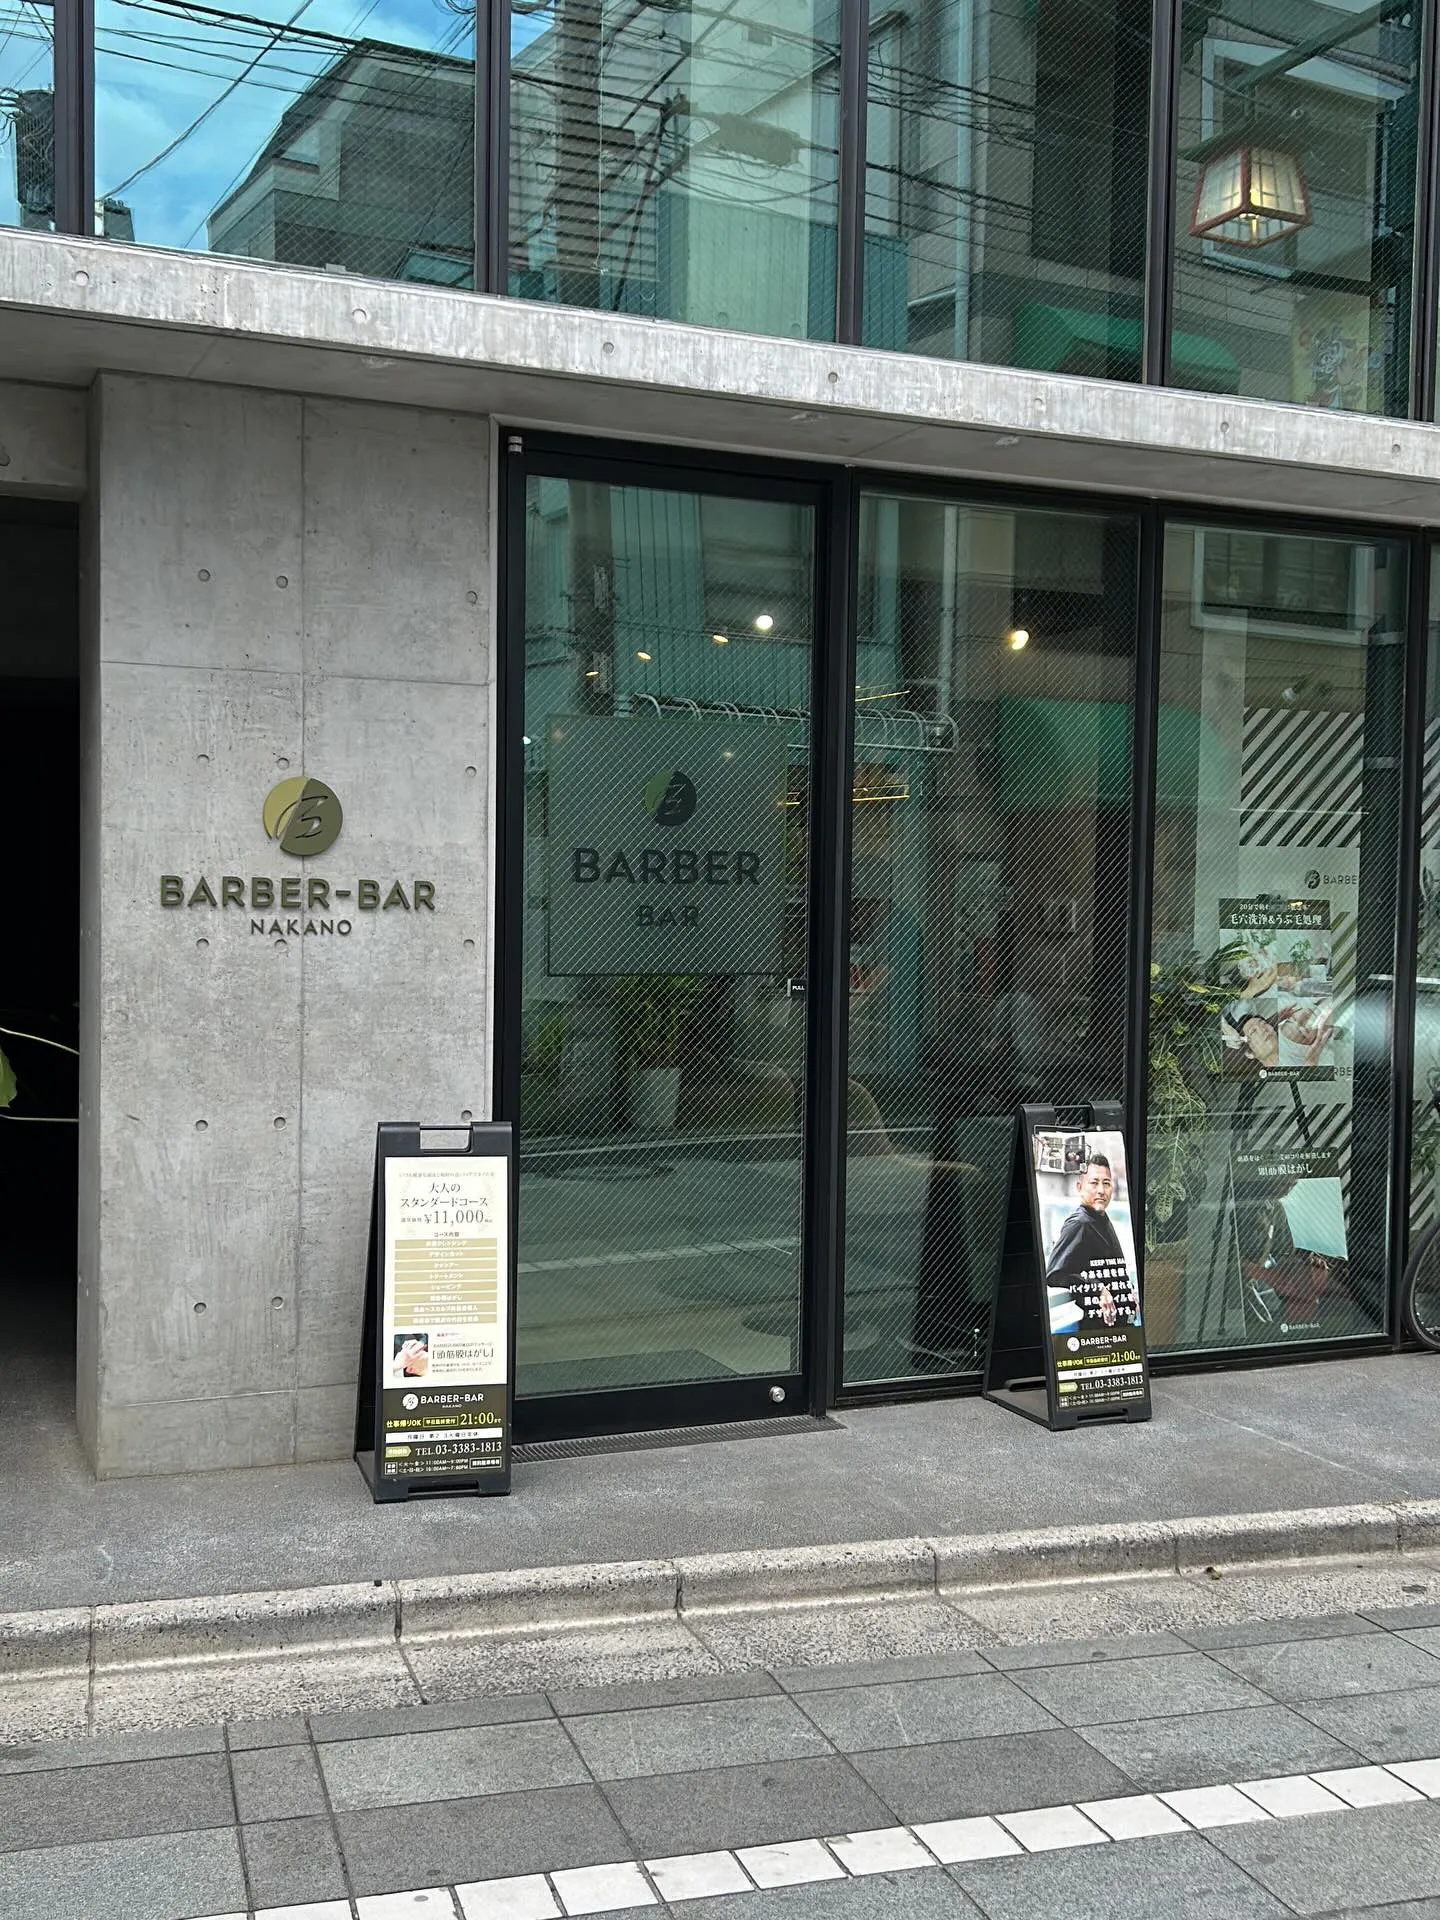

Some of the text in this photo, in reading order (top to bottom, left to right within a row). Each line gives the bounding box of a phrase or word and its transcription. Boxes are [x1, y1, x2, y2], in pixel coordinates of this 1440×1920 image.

[574, 847, 761, 885] BARBER
[160, 875, 436, 910] BARBER-BAR
[637, 904, 699, 928] BAR
[250, 918, 352, 936] NAKANO
[429, 1182, 461, 1194] 大人の
[400, 1196, 488, 1208] スタンダードコース
[1080, 1334, 1127, 1346] BARBER-BAR
[420, 1393, 484, 1404] BARBER-BAR
[386, 1419, 422, 1428] 仕事帰りOK
